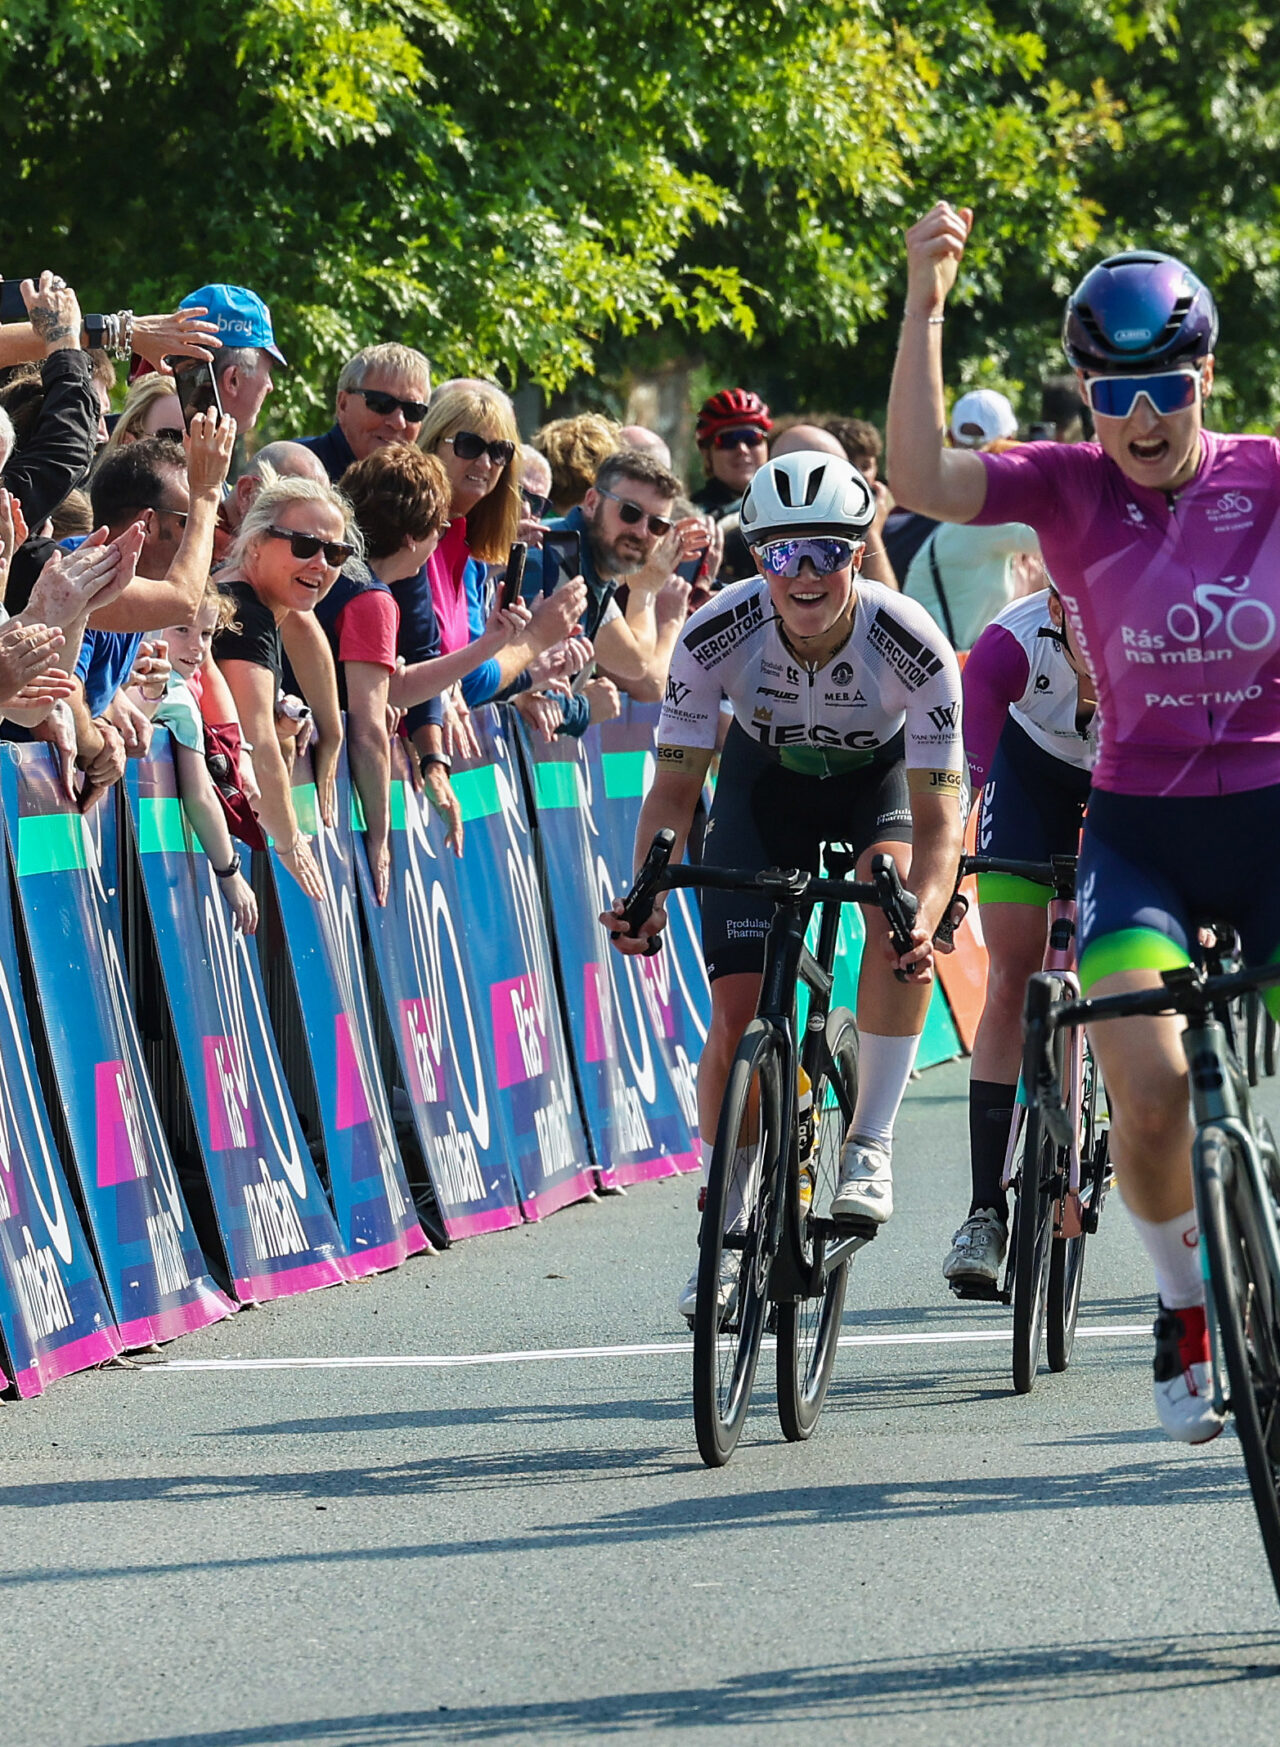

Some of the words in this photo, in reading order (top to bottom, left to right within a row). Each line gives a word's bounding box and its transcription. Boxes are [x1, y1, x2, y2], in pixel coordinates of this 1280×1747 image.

[217, 313, 253, 337] bray
[692, 608, 765, 665] HERCUTON
[1121, 625, 1166, 649] Rás
[869, 622, 929, 688] HERCUTON
[1125, 649, 1155, 664] na
[1161, 648, 1232, 664] mBan
[756, 687, 799, 700] FFWD
[1145, 685, 1262, 708] PACTIMO
[911, 733, 928, 741] VAN
[657, 748, 684, 758] EGG
[929, 771, 961, 786] JEGG
[726, 919, 771, 930] Produlab
[727, 928, 765, 940] Pharma
[510, 979, 544, 1079] Rás
[407, 1001, 437, 1102] Rás
[443, 1110, 487, 1203] mBan
[253, 1157, 310, 1258] mBan
[20, 1225, 76, 1338] mBan
